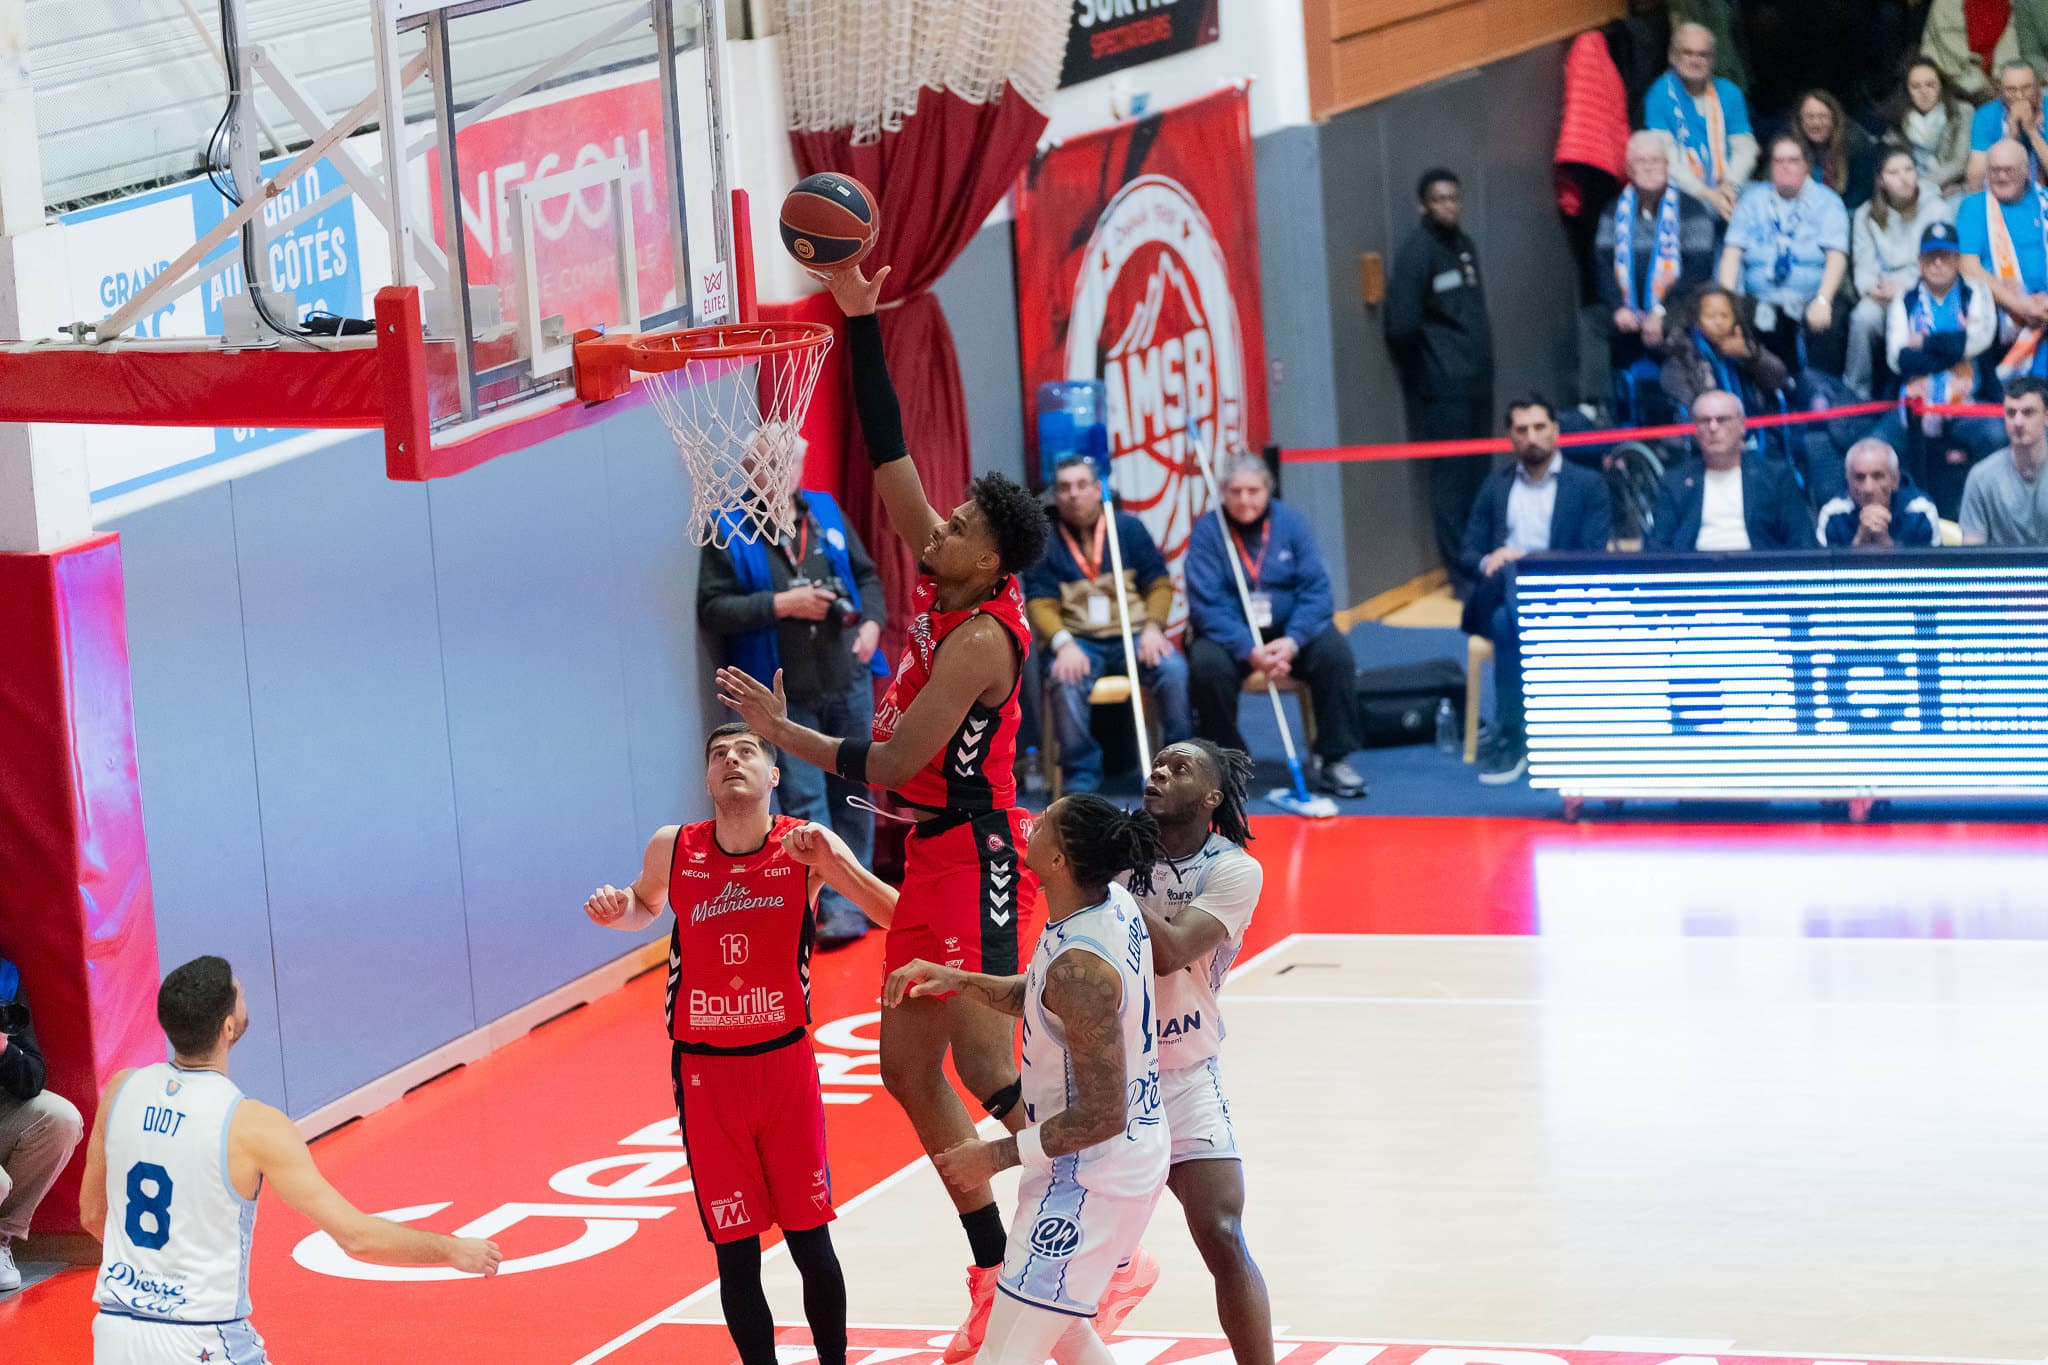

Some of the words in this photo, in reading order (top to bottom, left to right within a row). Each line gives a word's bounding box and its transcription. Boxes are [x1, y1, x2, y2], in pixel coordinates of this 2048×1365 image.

[269, 217, 347, 293] CÔTÉS
[1104, 327, 1213, 461] AMSB
[681, 869, 710, 879] NECOH
[714, 881, 751, 904] Aix
[691, 895, 785, 927] Maurienne
[719, 933, 749, 965] 13
[690, 986, 785, 1015] Bourille
[718, 1011, 785, 1026] ASSURANCES
[143, 1106, 186, 1137] DIOT
[125, 1161, 173, 1251] 8
